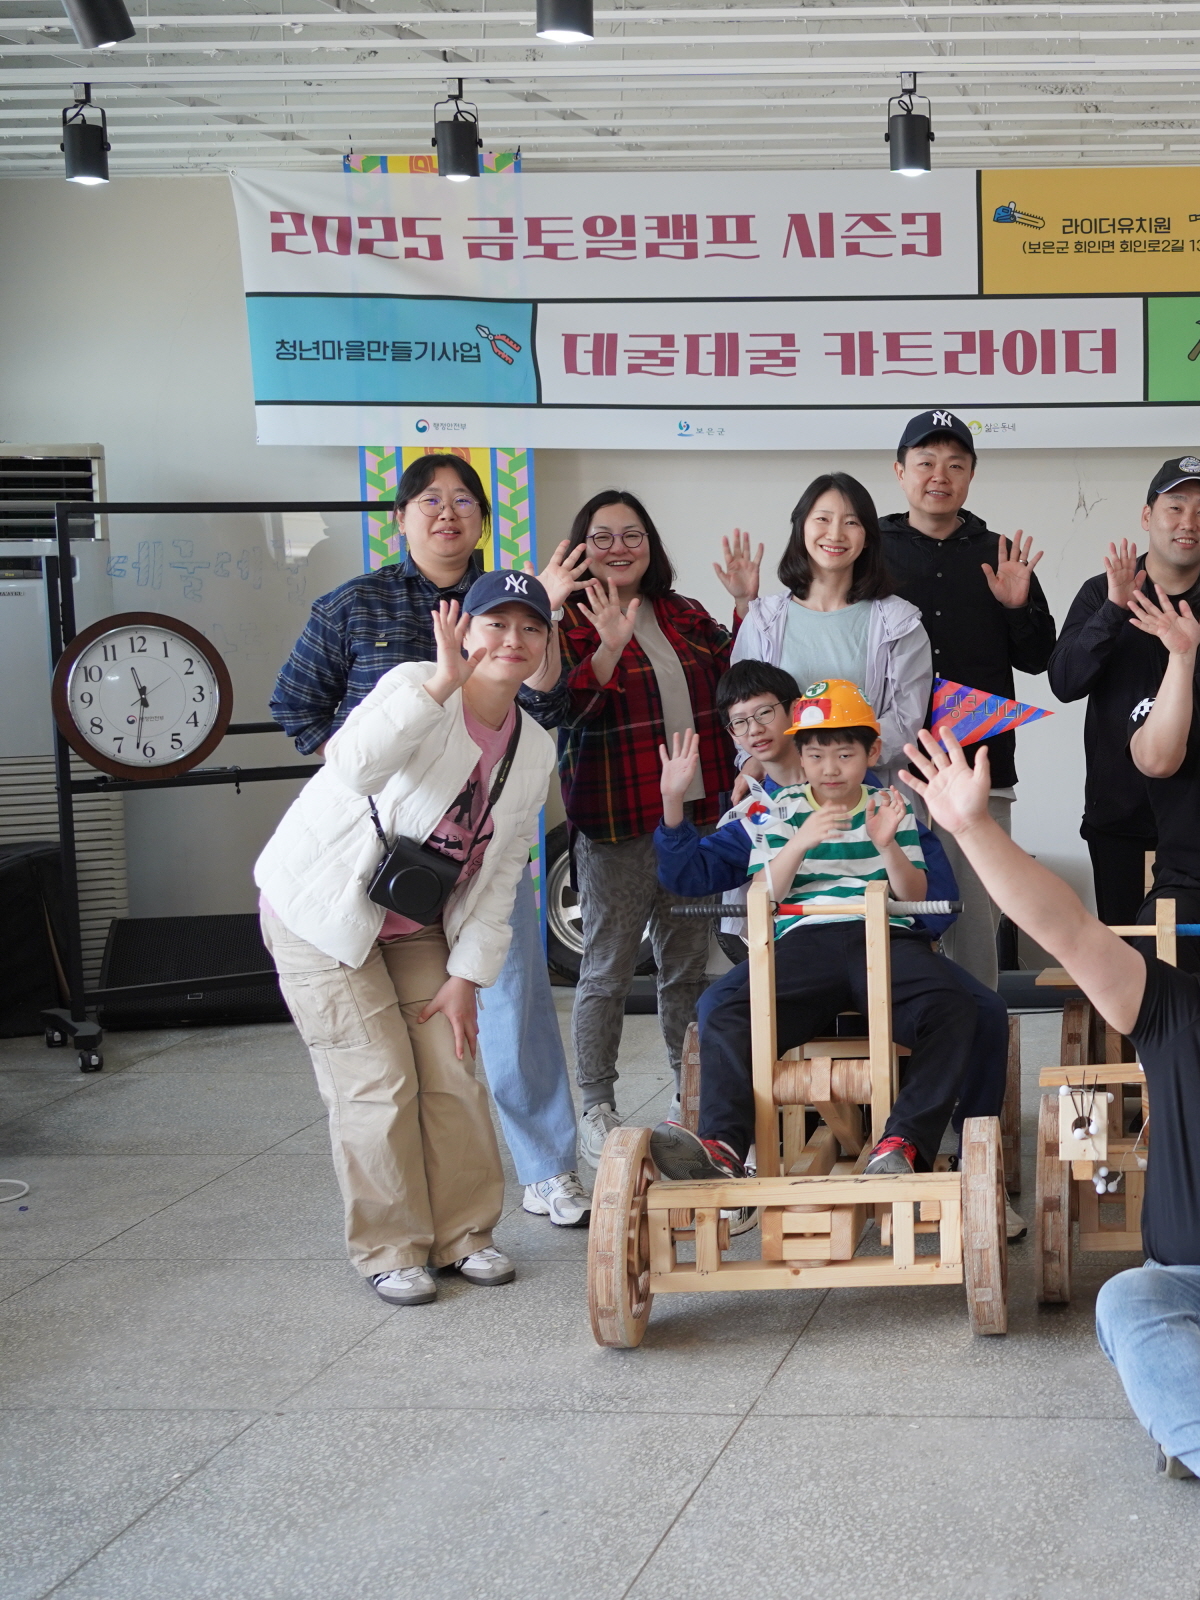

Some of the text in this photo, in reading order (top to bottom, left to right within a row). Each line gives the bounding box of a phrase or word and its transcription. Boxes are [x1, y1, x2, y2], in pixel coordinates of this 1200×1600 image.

[1062, 216, 1171, 235] 라이더유치원
[271, 212, 942, 261] 2025 금토일캠프 시즌3
[1022, 240, 1070, 256] (보은군
[1073, 239, 1115, 254] 회인면
[1119, 238, 1185, 254] 회인로2길
[275, 338, 482, 363] 청년마을만들기사업
[562, 328, 1117, 378] 데굴데굴 카트라이더
[433, 422, 467, 431] 행정안전부
[932, 410, 953, 428] NY
[695, 427, 726, 436] 보은군
[504, 573, 529, 595] NY
[102, 644, 118, 662] 11
[129, 635, 148, 653] 12
[162, 641, 170, 658] 1
[82, 665, 103, 683] 10
[183, 658, 195, 676] 2
[79, 692, 94, 709] 9
[192, 685, 206, 703] 3
[90, 716, 104, 735] 8
[185, 711, 200, 728] 4
[112, 737, 125, 754] 7
[142, 740, 156, 759] 6
[170, 733, 184, 750] 5
